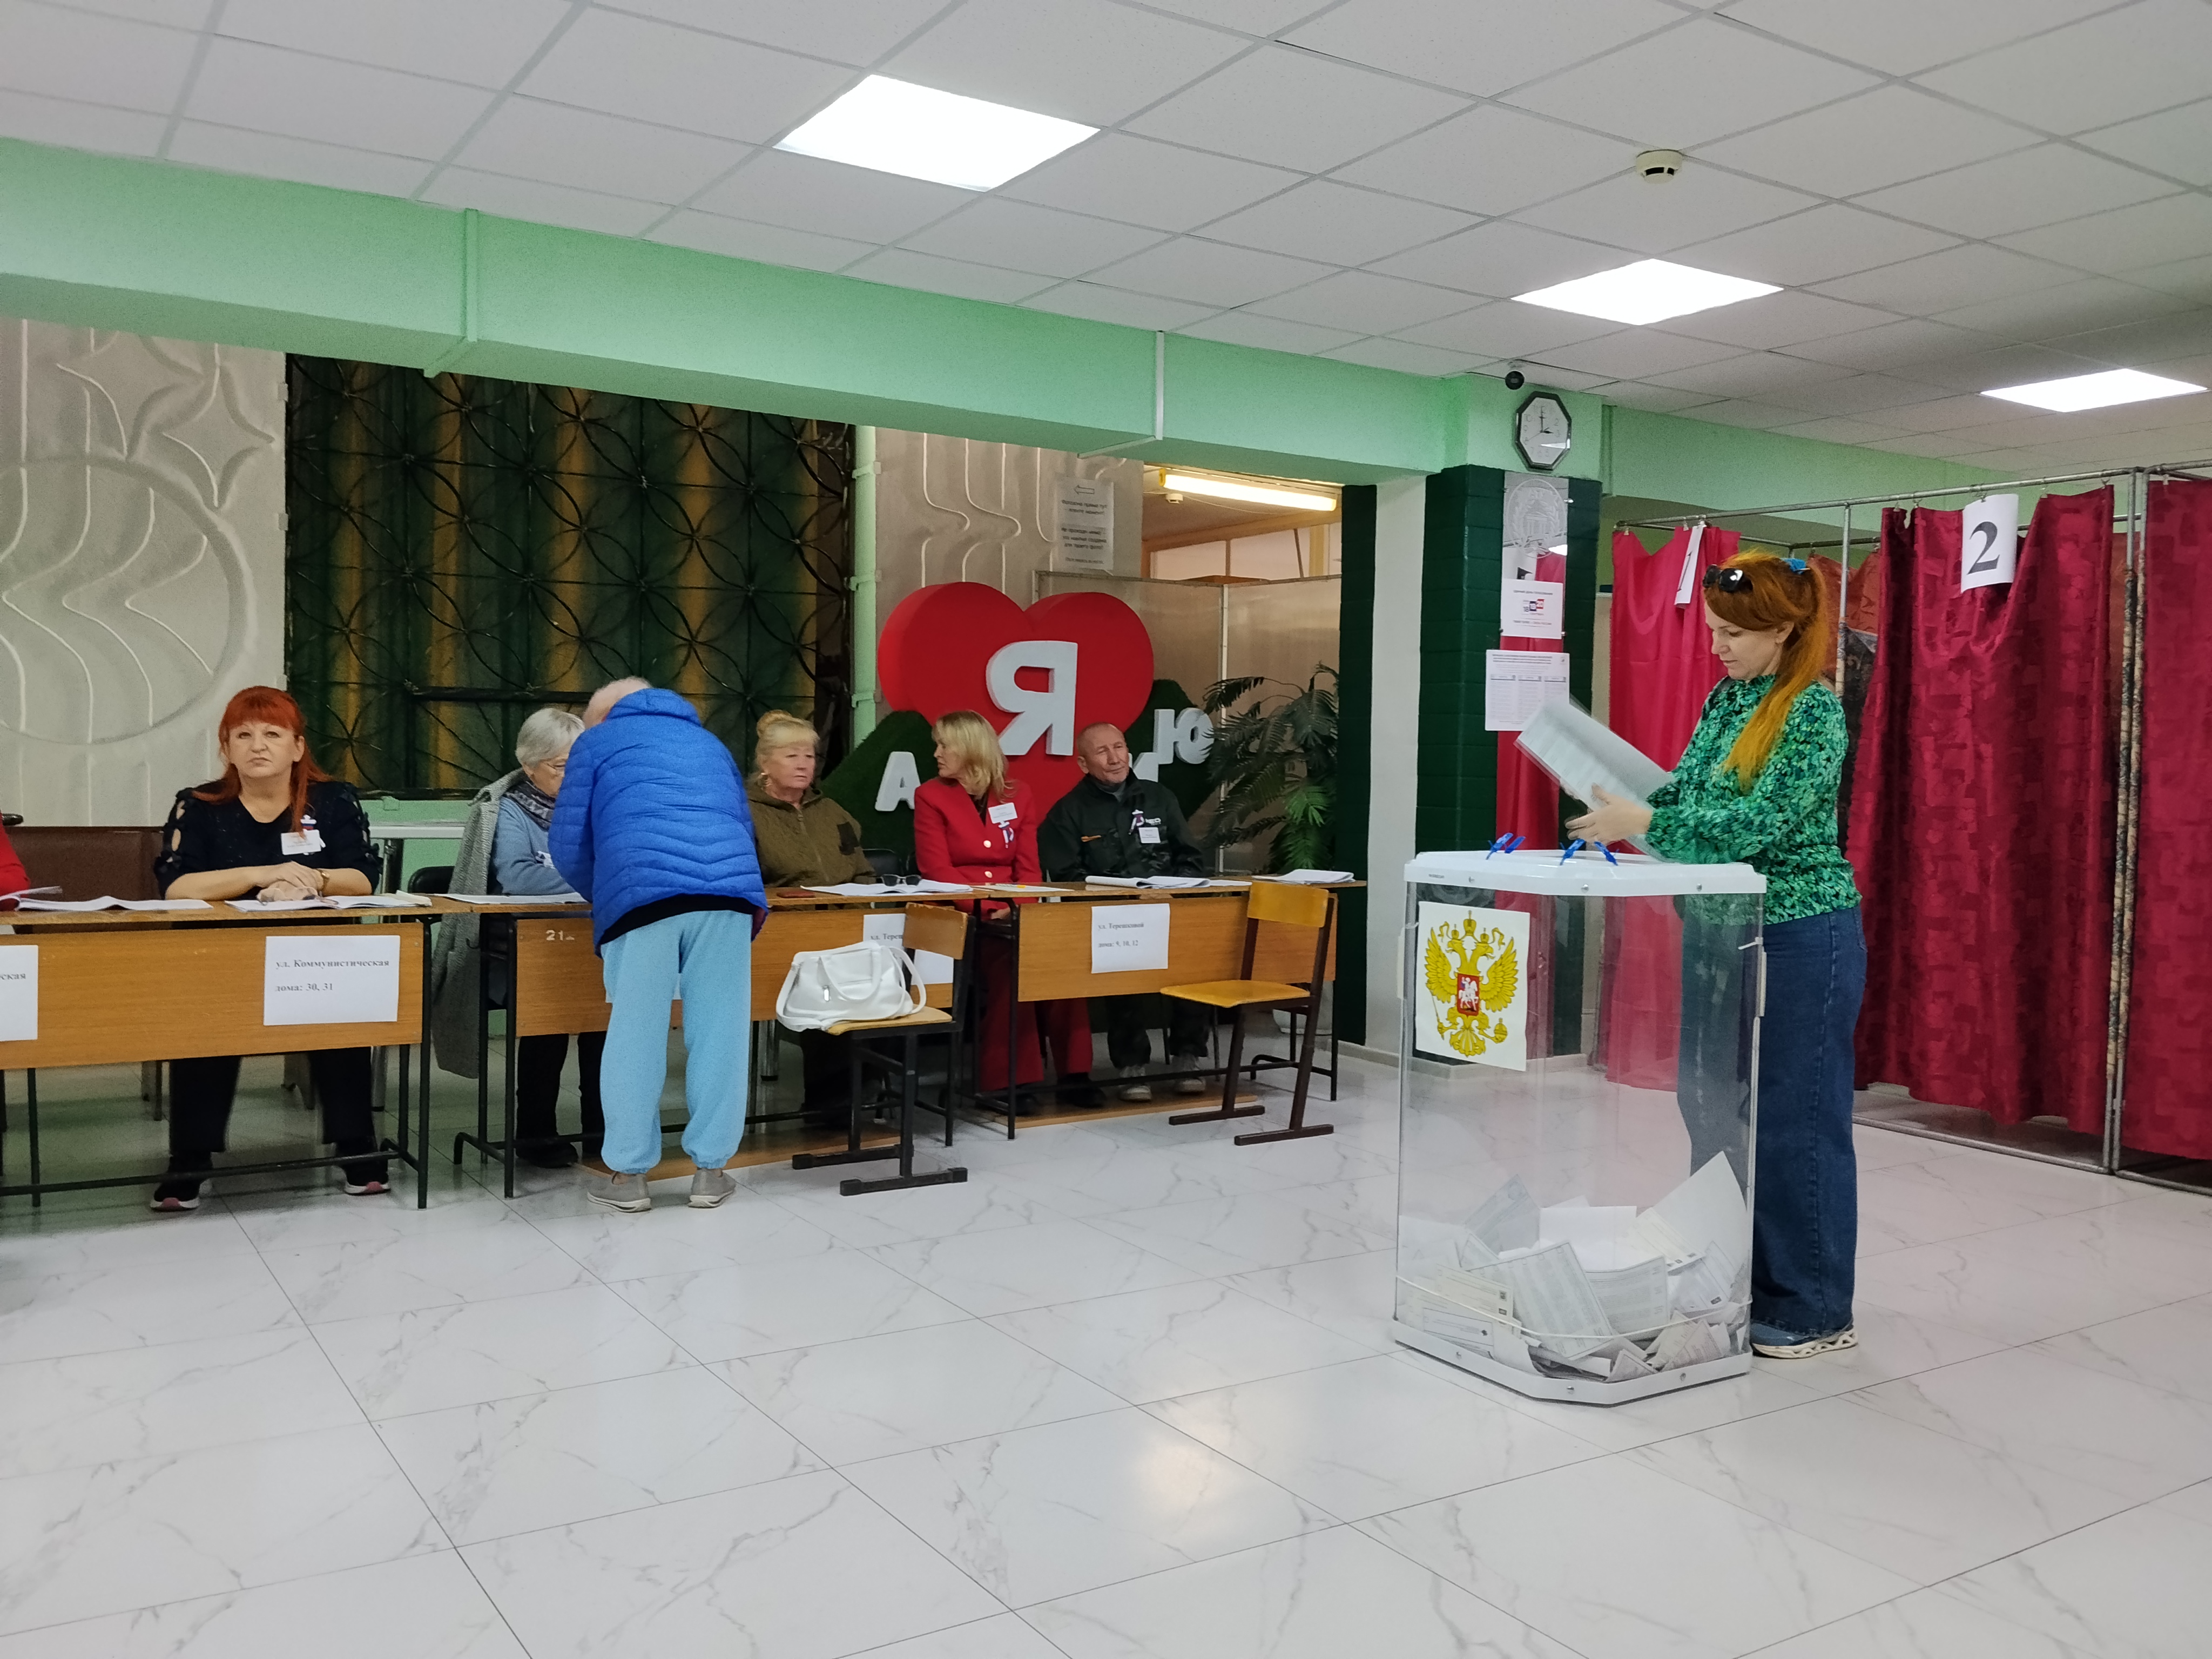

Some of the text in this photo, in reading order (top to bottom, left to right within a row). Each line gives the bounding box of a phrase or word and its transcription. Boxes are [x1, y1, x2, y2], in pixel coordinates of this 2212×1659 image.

[1967, 521, 2000, 576] 2
[986, 640, 1078, 756] Я
[276, 959, 389, 970] ул. Коммунистическая
[306, 982, 320, 991] 30,
[322, 982, 333, 990] 31
